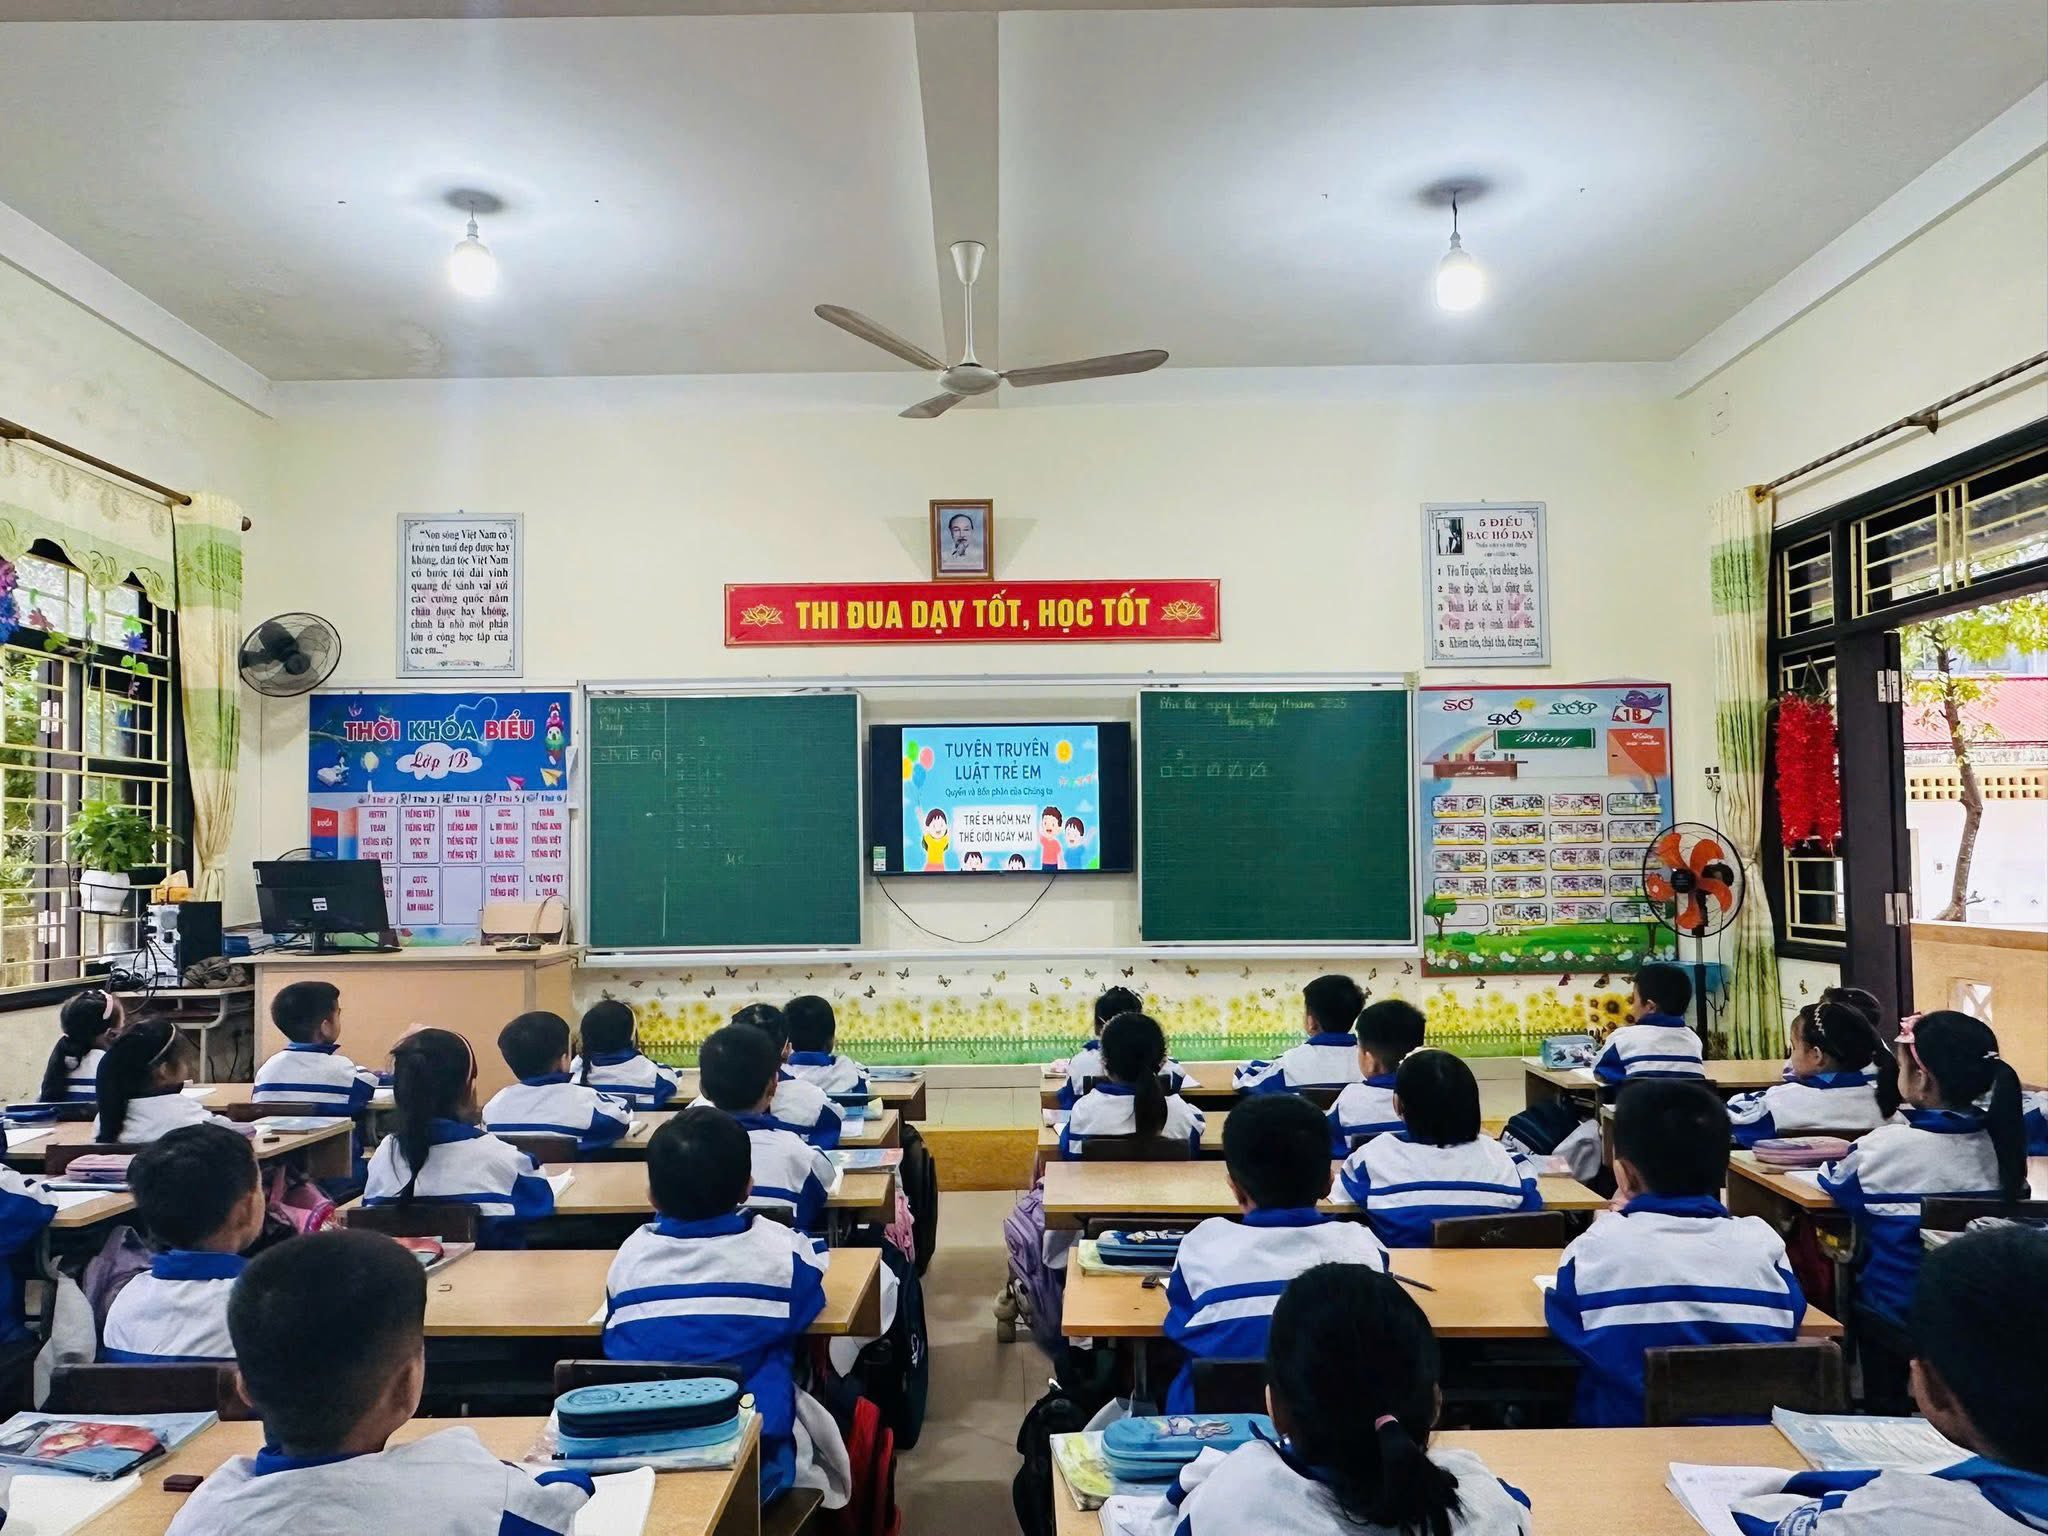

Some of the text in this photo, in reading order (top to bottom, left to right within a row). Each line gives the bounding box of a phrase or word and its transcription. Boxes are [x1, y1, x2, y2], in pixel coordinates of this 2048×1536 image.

[1479, 518, 1486, 527] 5
[479, 530, 496, 539] Nam
[1512, 530, 1534, 540] DẠY
[490, 555, 509, 564] Nam
[796, 588, 1150, 634] THI ĐUA DẠY TỐT, HỌC TỐT
[1623, 708, 1642, 721] 1B
[344, 709, 535, 741] THỜI KHÓA BIỂU
[945, 739, 992, 758] TUYÊN
[410, 750, 469, 771] Lớp 1B
[956, 760, 1041, 784] LUẬT TRẺ EM
[964, 811, 1031, 825] TRẺ EM HÔM NAY
[959, 829, 974, 842] THẾ
[976, 829, 992, 842] GIỚI
[1018, 831, 1033, 841] MAI
